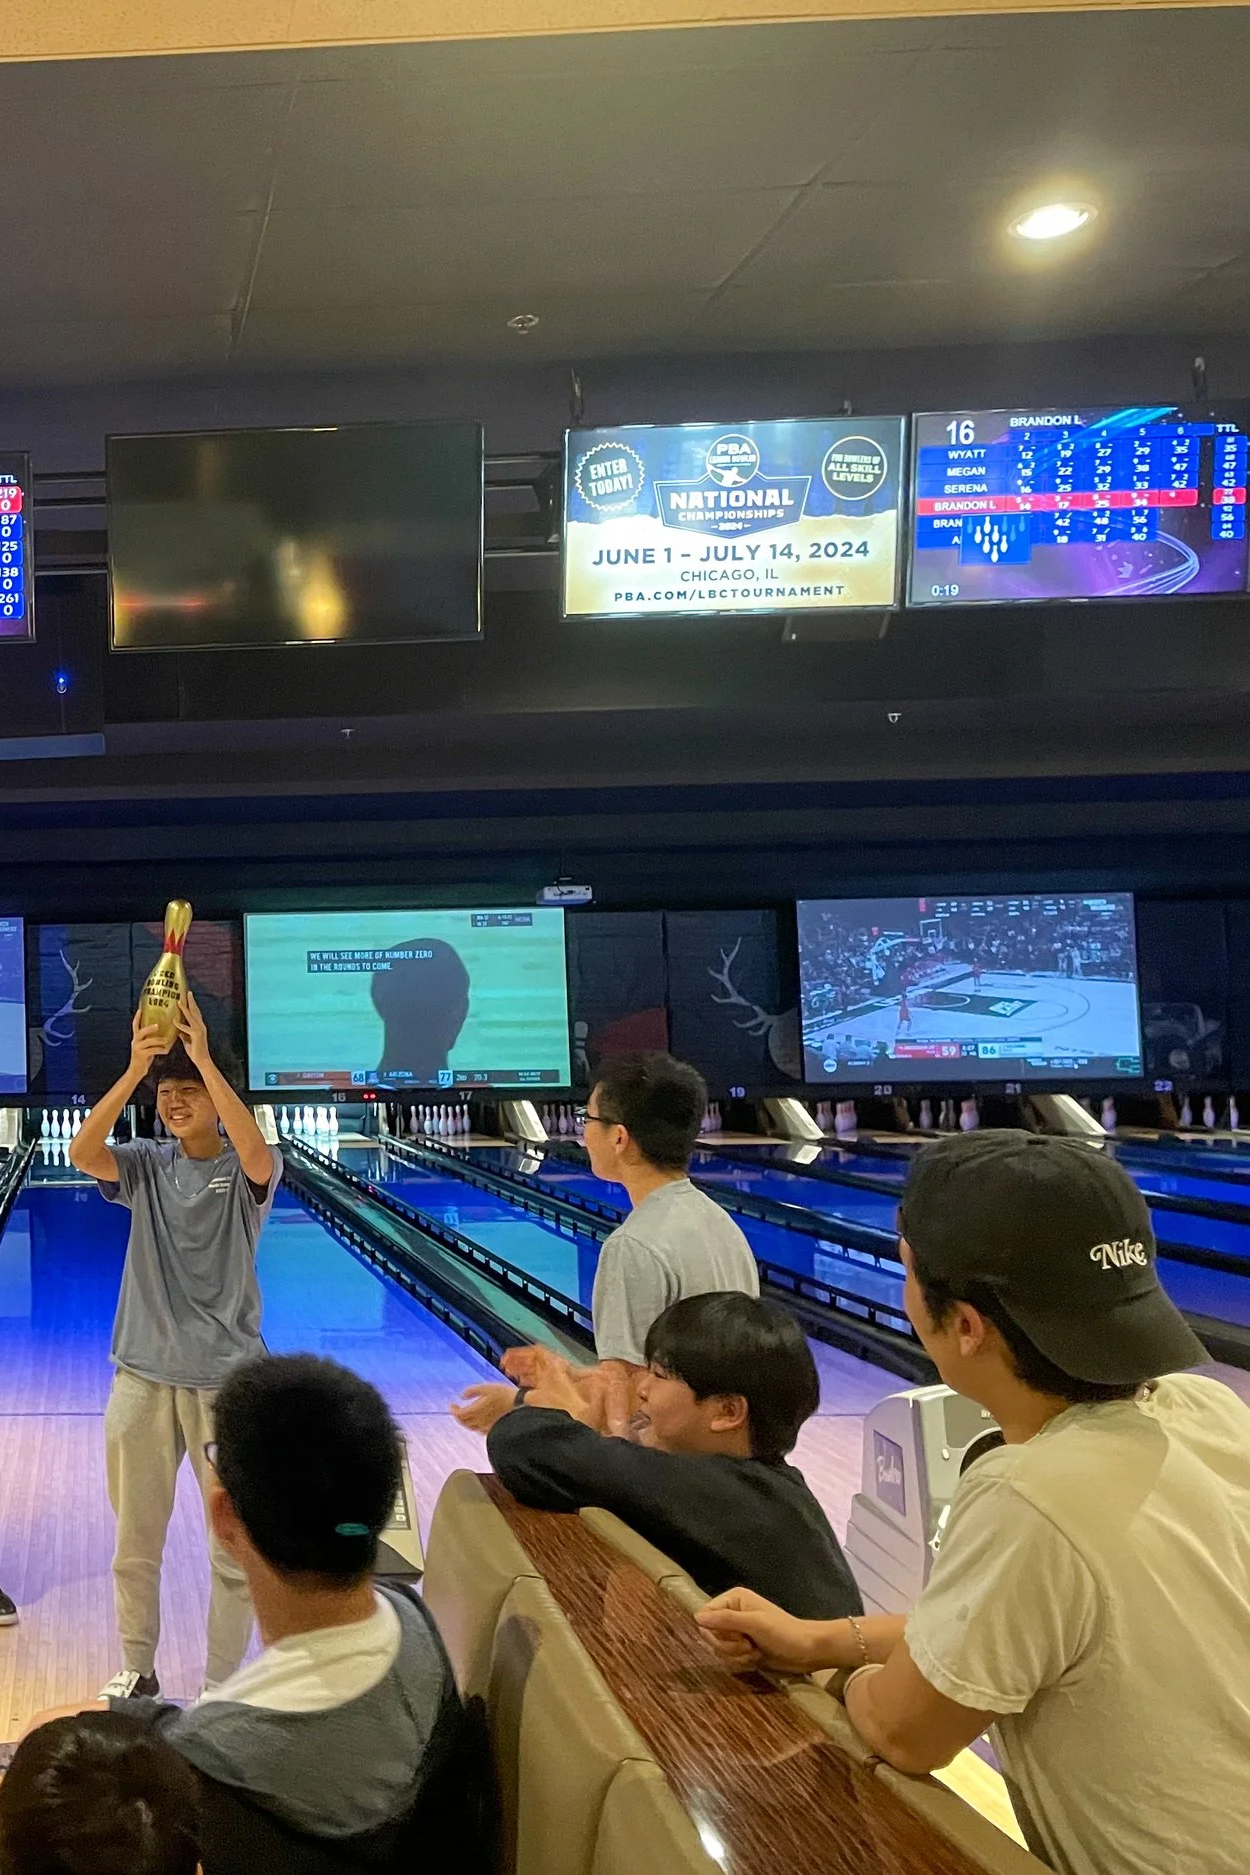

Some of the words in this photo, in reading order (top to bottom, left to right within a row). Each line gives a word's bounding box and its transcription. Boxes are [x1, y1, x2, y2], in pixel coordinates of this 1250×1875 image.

[946, 420, 975, 445] 16
[1010, 415, 1071, 427] BRANDON
[1073, 415, 1082, 425] L
[1216, 424, 1239, 433] TTL
[716, 443, 751, 455] PBA
[948, 449, 986, 460] WYATT
[1021, 451, 1033, 459] 12
[1060, 450, 1073, 458] 19
[1097, 449, 1111, 457] 27
[1135, 447, 1150, 456] 29
[1174, 446, 1188, 454] 35
[1224, 445, 1237, 453] 35
[589, 458, 628, 479] ENTER
[827, 462, 849, 472] ALL
[850, 464, 882, 474] SKILL
[947, 467, 986, 477] MEGAN
[1096, 466, 1111, 474] 29
[1173, 463, 1188, 471] 47
[1222, 462, 1237, 470] 47
[832, 472, 874, 483] LEVELS
[588, 474, 634, 497] TODAY!
[944, 484, 988, 494] SERENA
[1057, 484, 1072, 493] 25
[1096, 483, 1110, 491] 32
[1134, 481, 1149, 490] 33
[1172, 480, 1187, 488] 42
[1222, 479, 1236, 487] 42
[669, 488, 795, 510] NATIONAL
[1, 500, 10, 511] 0
[934, 501, 987, 512] BRANDON
[989, 500, 996, 510] L
[678, 508, 785, 522] CHAMPIONSHIPS
[1055, 518, 1071, 527] 42
[1133, 516, 1147, 524] 56
[1220, 513, 1235, 521] 56
[1, 526, 11, 537] 0
[1095, 534, 1106, 542] 31
[1132, 533, 1146, 541] 40
[1219, 530, 1234, 538] 40
[2, 552, 12, 563] 0
[592, 548, 655, 566] JUNE
[663, 547, 672, 563] 1
[700, 544, 761, 562] JULY
[768, 543, 801, 562] 14,
[809, 541, 870, 559] 2024
[680, 568, 760, 583] CHICAGO,
[765, 568, 779, 580] IL
[3, 578, 12, 589] 0
[614, 585, 845, 602] PBA.COM/LBCTOURNAMENT
[931, 584, 959, 596] 0:19
[3, 605, 13, 616] 0
[310, 952, 321, 960] WE
[323, 952, 338, 960] WILL
[341, 952, 352, 960] SEE
[355, 951, 373, 960] MORE
[375, 951, 383, 959] OF
[385, 950, 413, 959] NUMBER
[415, 950, 433, 959] ZERO
[320, 963, 332, 971] THE
[334, 963, 360, 971] ROUNDS
[362, 962, 370, 970] TO
[942, 1046, 956, 1055] 59
[982, 1046, 996, 1055] 86
[353, 1074, 364, 1083] 68
[440, 1072, 450, 1081] 77
[459, 1091, 473, 1100] 17
[874, 1085, 892, 1095] 20
[71, 1094, 85, 1104] 14
[1090, 1238, 1148, 1270] Nike
